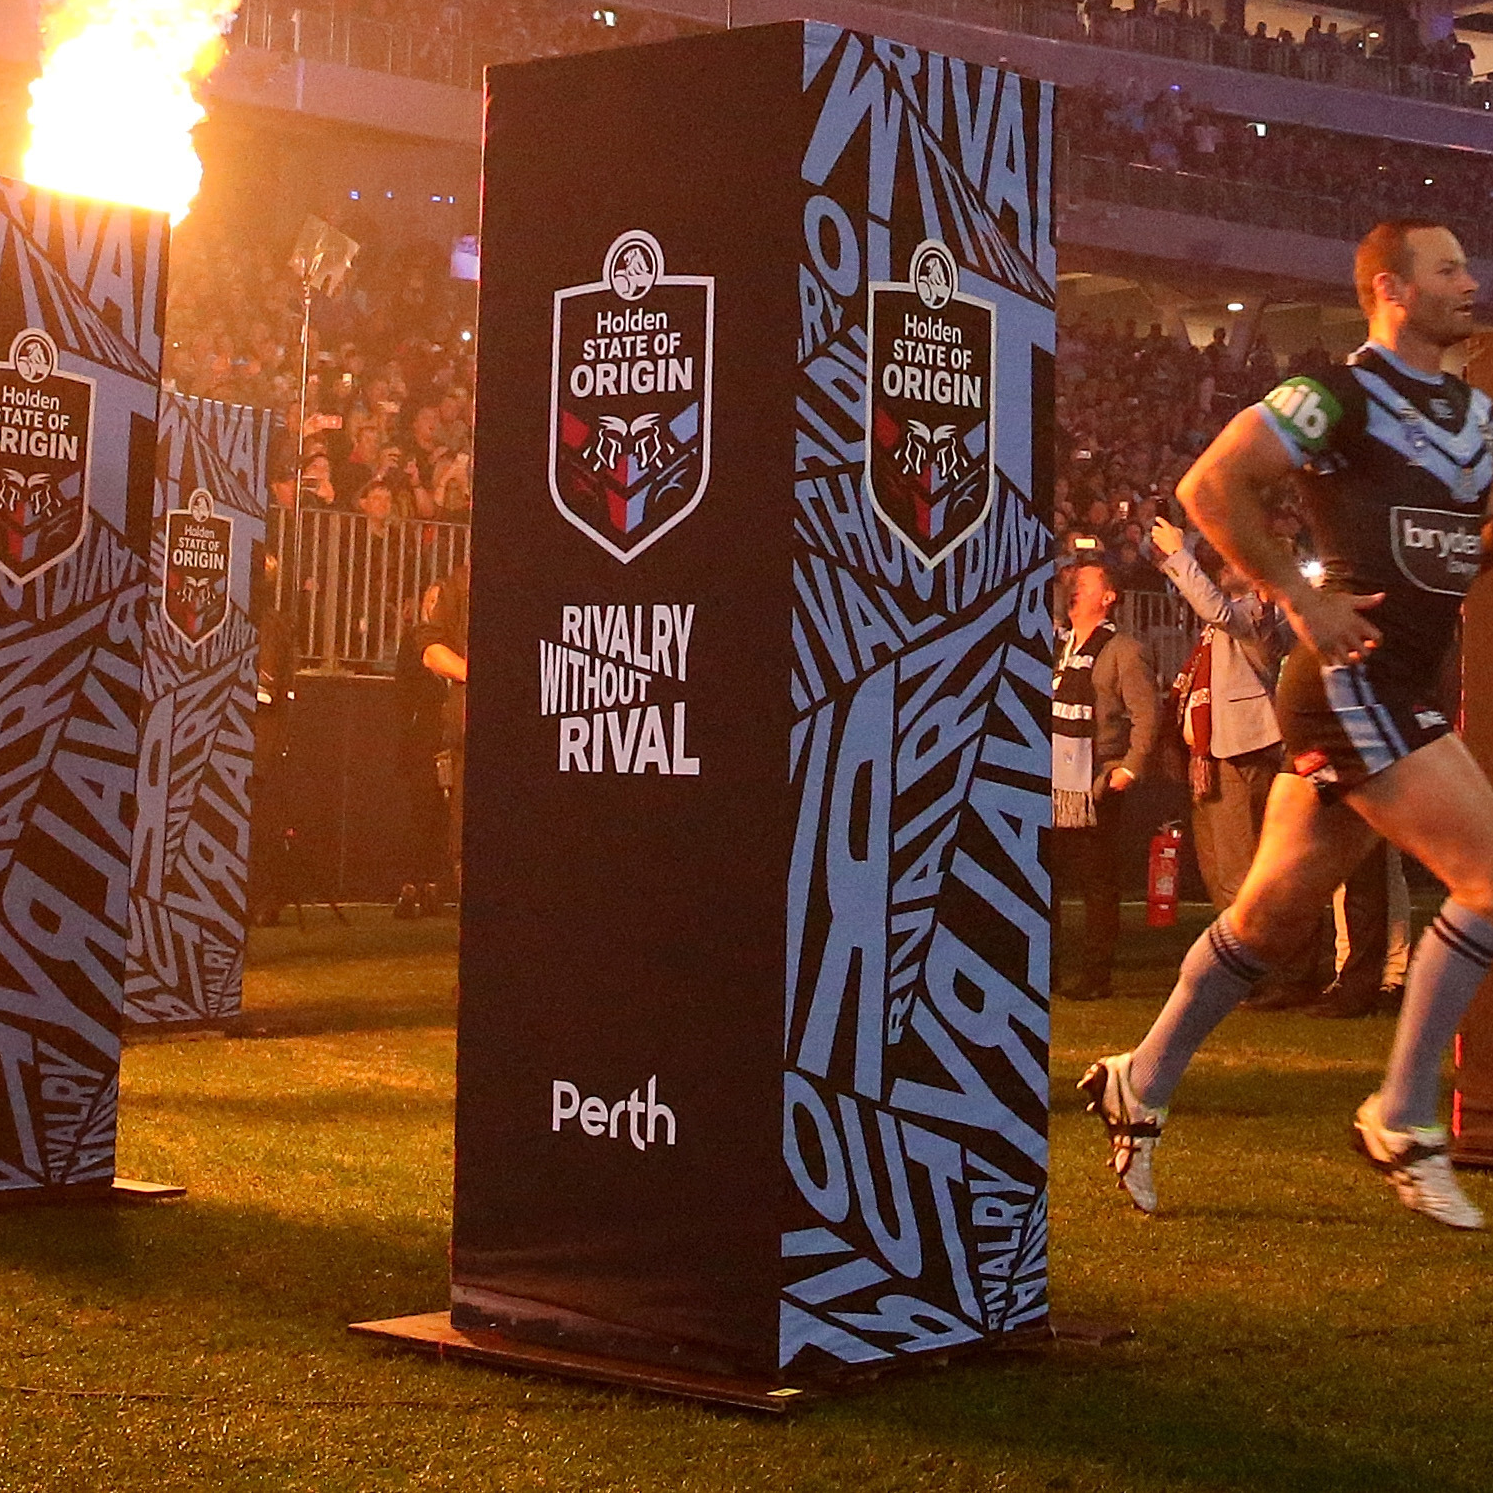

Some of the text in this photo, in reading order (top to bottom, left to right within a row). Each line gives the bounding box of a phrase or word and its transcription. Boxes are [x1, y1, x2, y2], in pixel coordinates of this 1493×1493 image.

[596, 307, 668, 335] Holden
[904, 313, 962, 345] Holden
[582, 332, 682, 361] STATE OF
[893, 338, 972, 371] STATE OF
[570, 357, 693, 398] ORIGIN
[882, 363, 982, 408] ORIGIN
[2, 385, 60, 410] Holden
[48, 413, 70, 431] OF
[172, 548, 224, 570] ORIGIN
[178, 537, 221, 552] STATE OF
[562, 604, 695, 682] RIVALRY
[539, 639, 652, 716] WITHOUT
[559, 701, 700, 775] RIVAL
[552, 1074, 676, 1151] Perth
